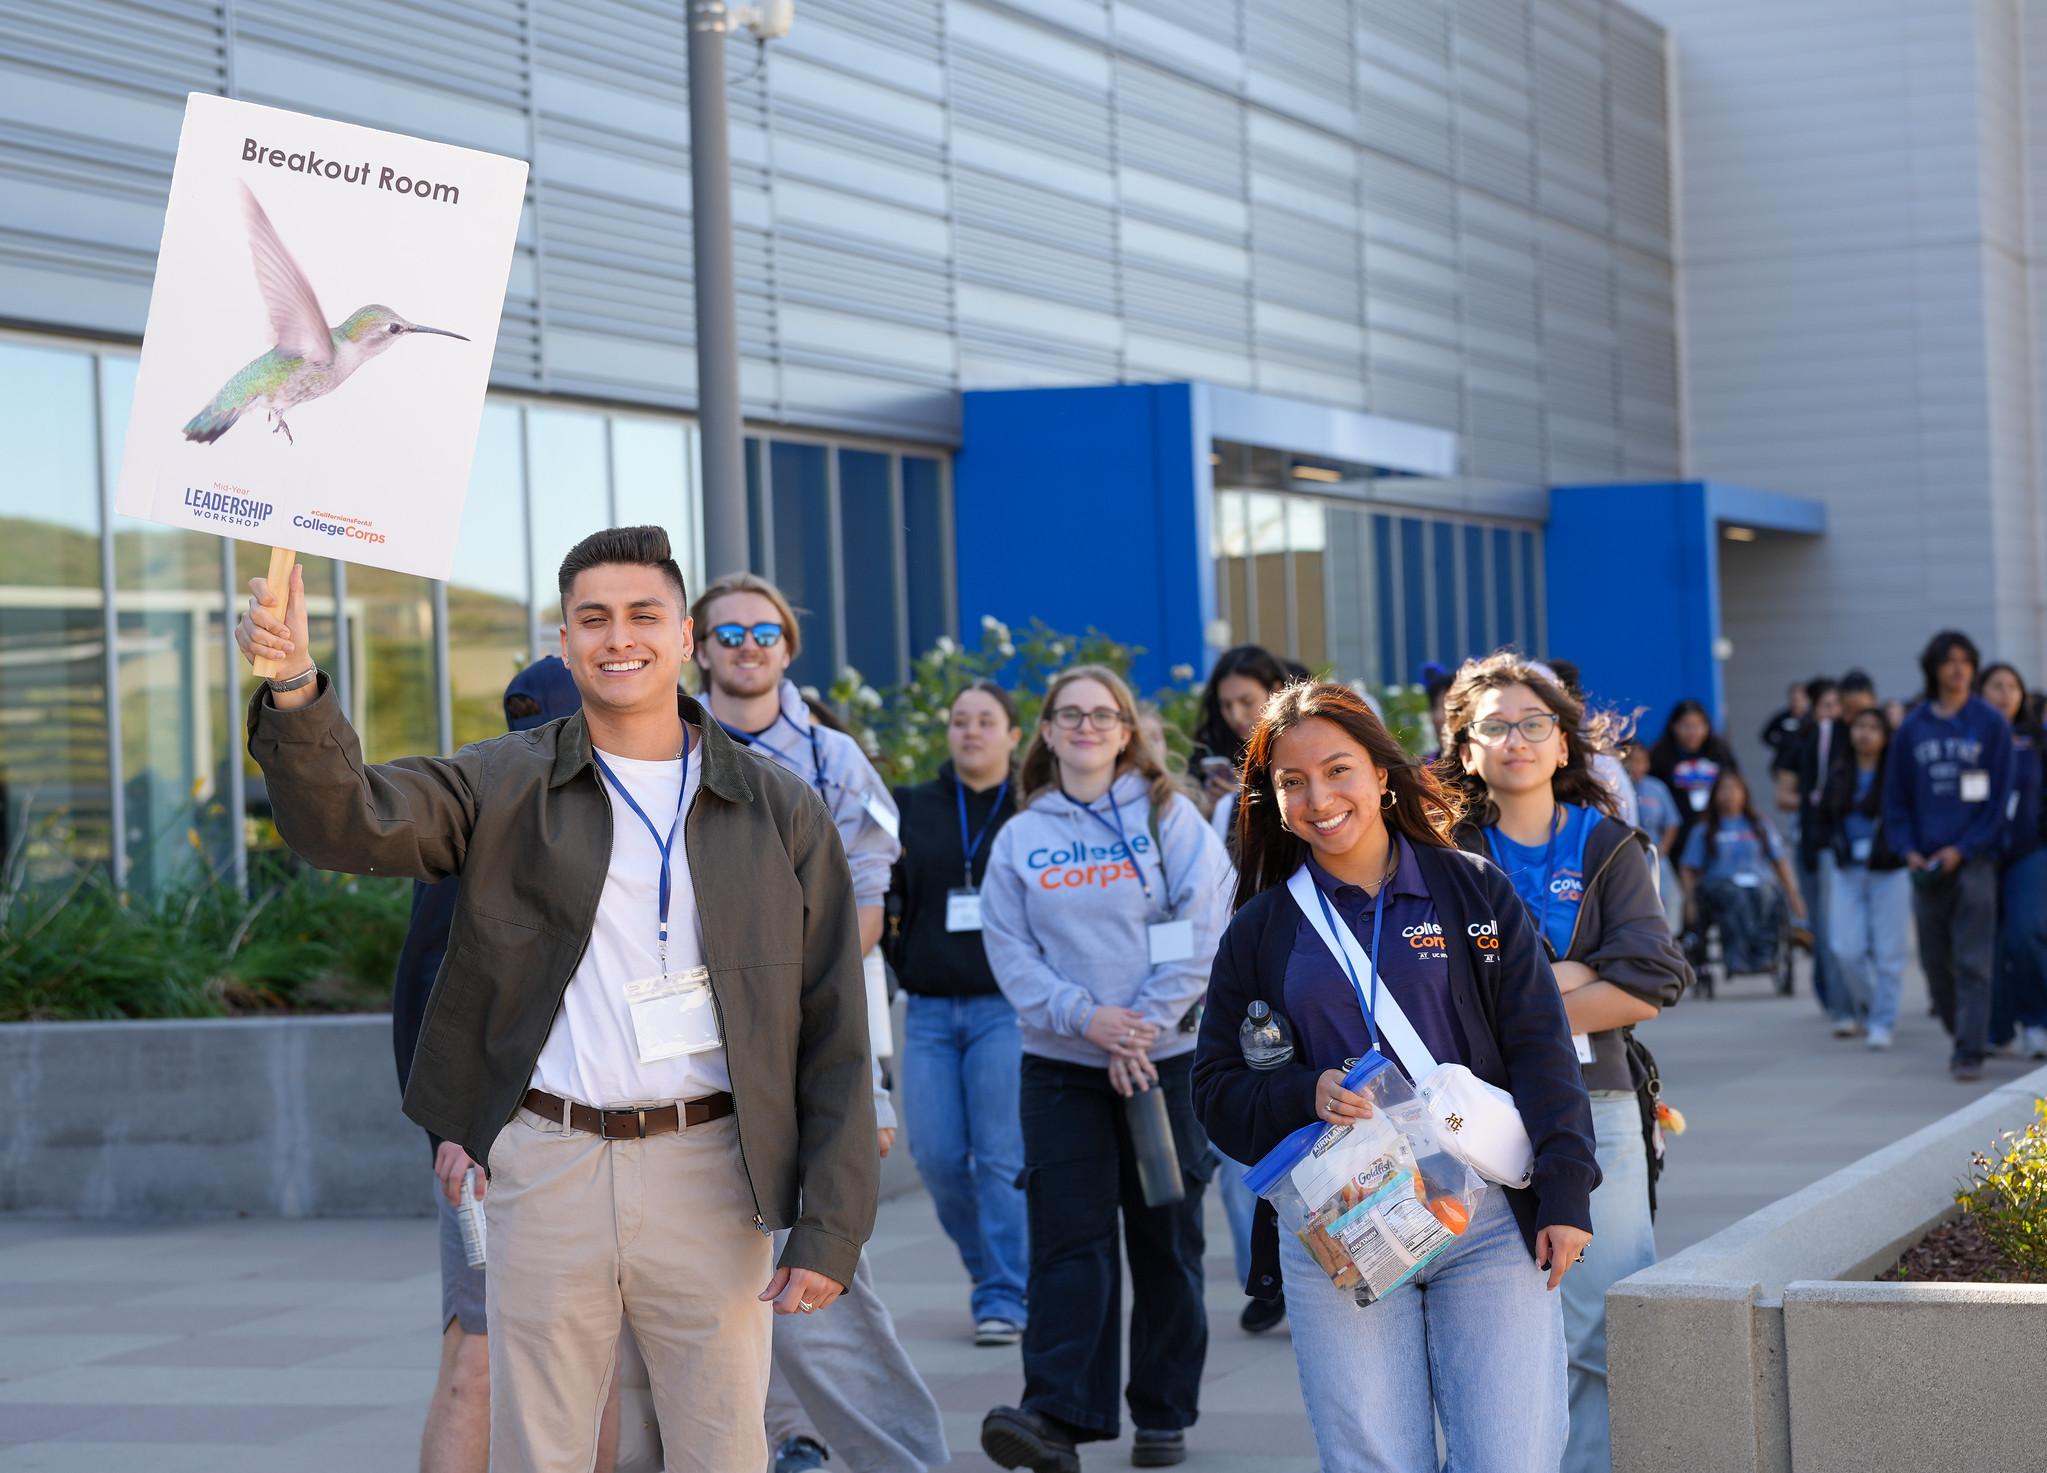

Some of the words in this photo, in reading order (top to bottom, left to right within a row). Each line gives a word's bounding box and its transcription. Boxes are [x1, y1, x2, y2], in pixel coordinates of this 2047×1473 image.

[241, 137, 371, 185] Breakout
[378, 166, 460, 205] Room
[213, 481, 251, 496] Mid-Year
[184, 487, 273, 521] LEADERSHIP
[193, 508, 260, 528] WORKSHOP
[310, 510, 373, 527] #CaliforniansForAll
[1027, 835, 1150, 869] College
[1039, 859, 1138, 890] Corps
[1402, 922, 1443, 938] Colle
[1467, 920, 1499, 937] Coll
[1358, 1159, 1394, 1186] Goldfish
[1350, 1230, 1378, 1253] KIRKLAND
